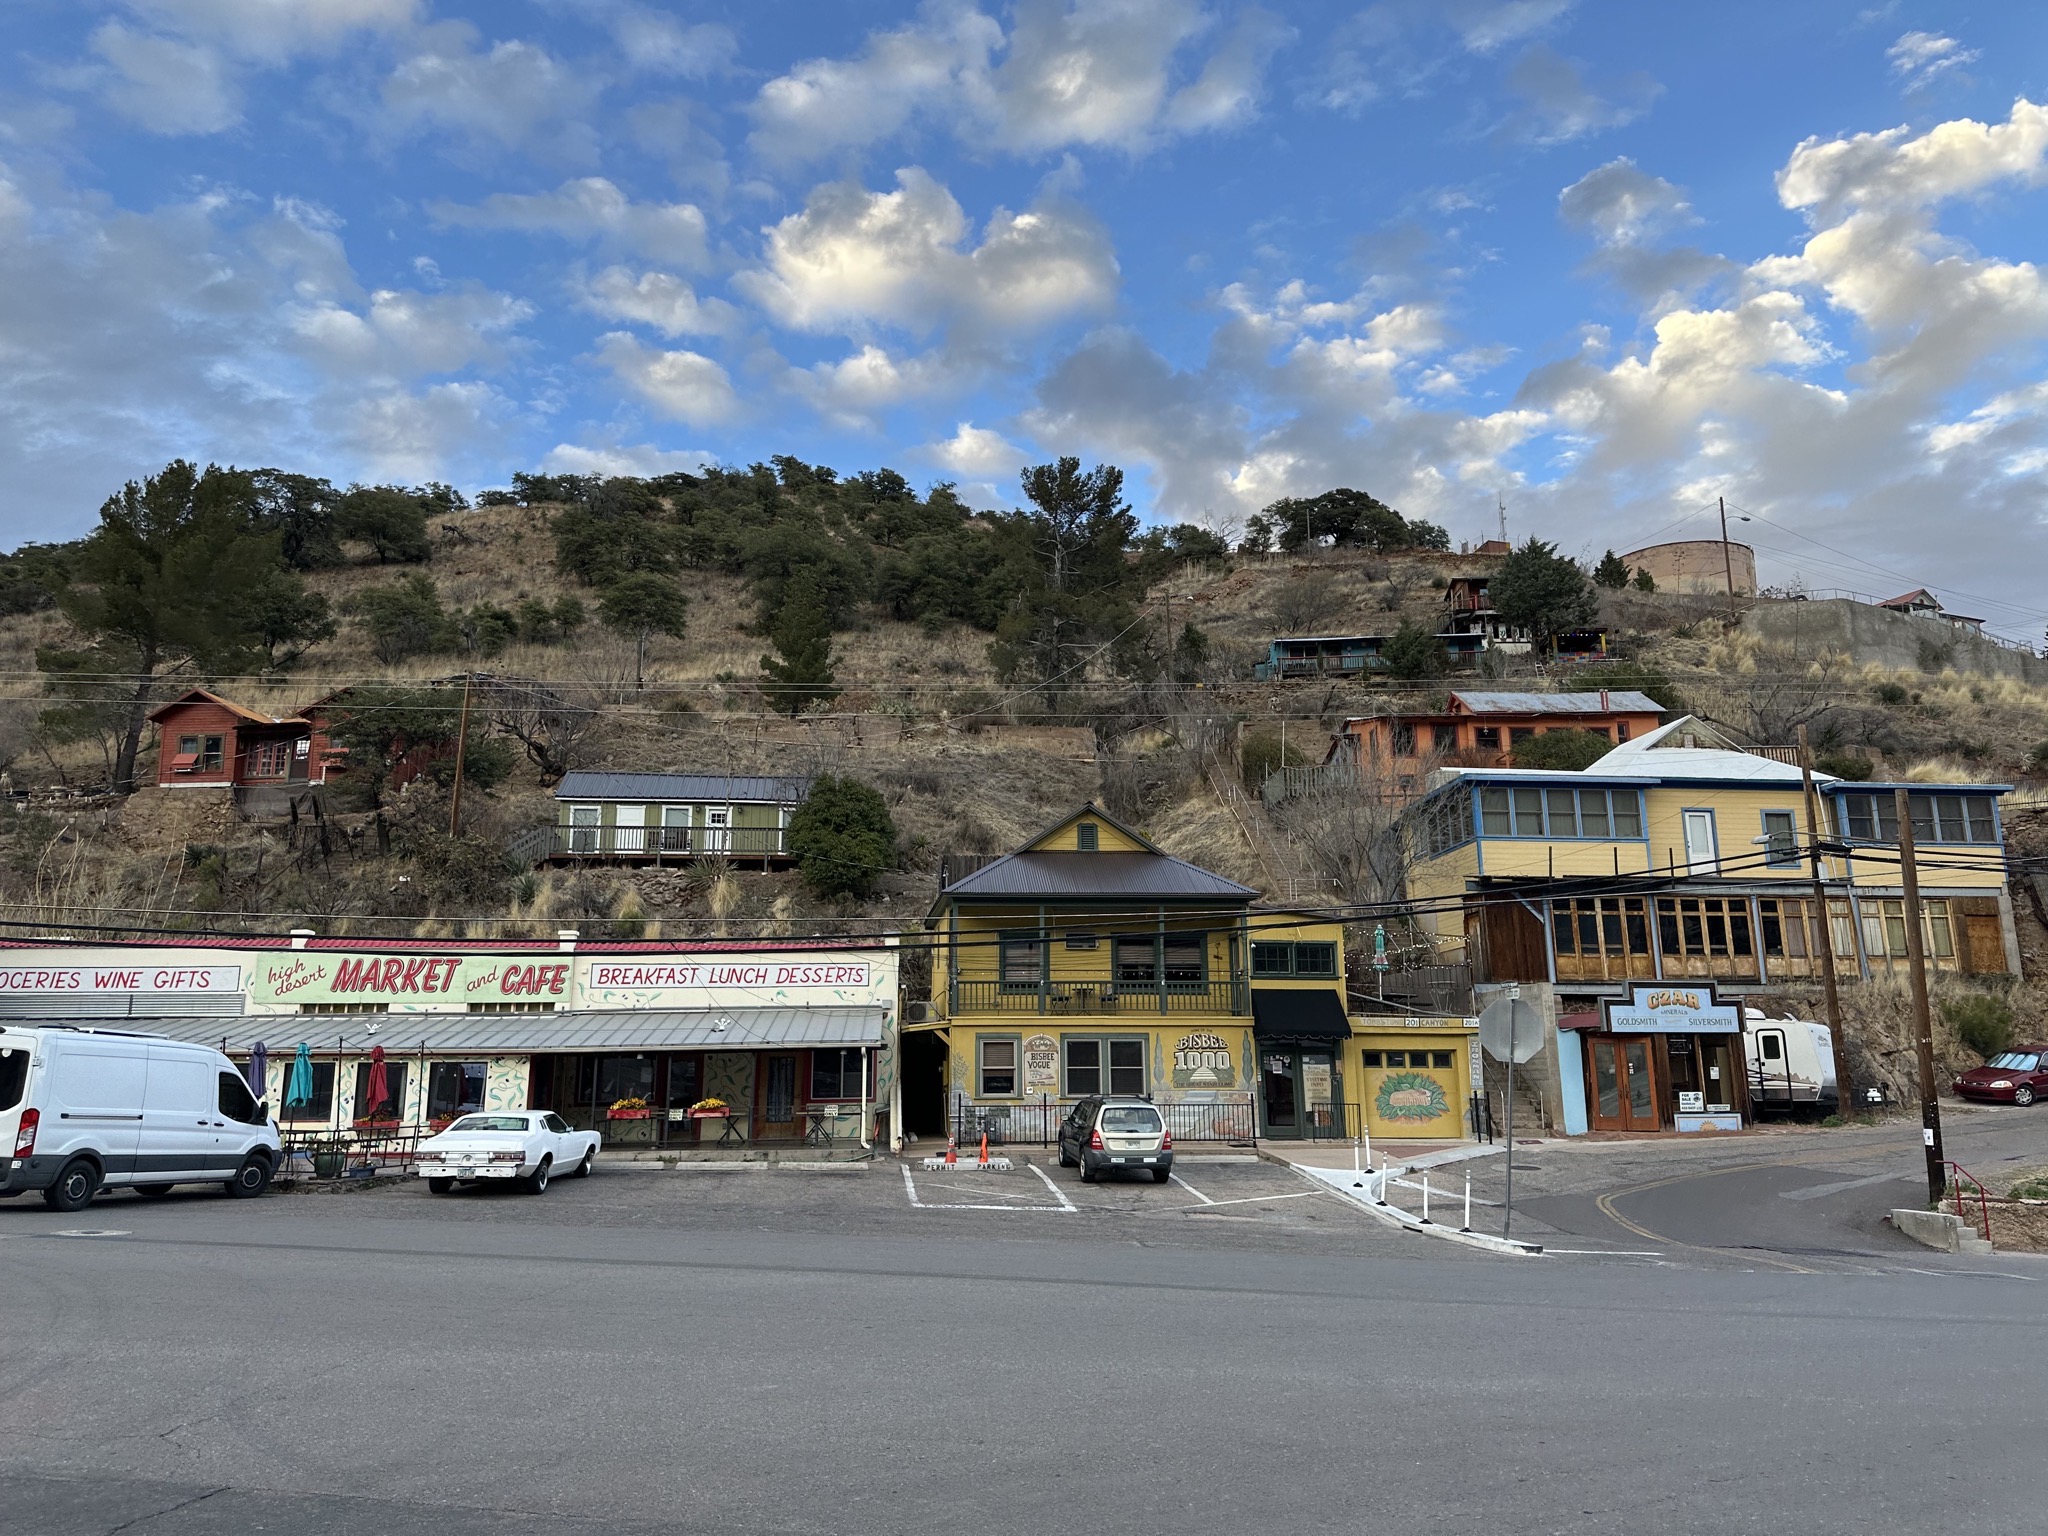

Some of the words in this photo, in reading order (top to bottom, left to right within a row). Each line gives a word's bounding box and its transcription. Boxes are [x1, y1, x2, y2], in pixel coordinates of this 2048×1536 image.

[95, 971, 144, 989] WINE
[154, 971, 211, 988] GIFTS
[268, 958, 306, 984] high
[330, 958, 463, 994] MARKET
[467, 965, 499, 992] and
[500, 965, 569, 995] CAFE
[597, 967, 700, 985] BREAKFAST
[709, 967, 768, 985] LUNCH
[776, 967, 864, 984] DESSERTS
[275, 965, 327, 996] desert
[1647, 990, 1700, 1010] CZAR
[1421, 1018, 1449, 1026] CANYON
[1617, 1017, 1658, 1026] GOLDSMITH
[1688, 1017, 1733, 1026] SILVERSMITH
[1174, 1033, 1230, 1050] BISBEE
[1027, 1061, 1051, 1069] VOGUE
[1174, 1051, 1231, 1071] 1000
